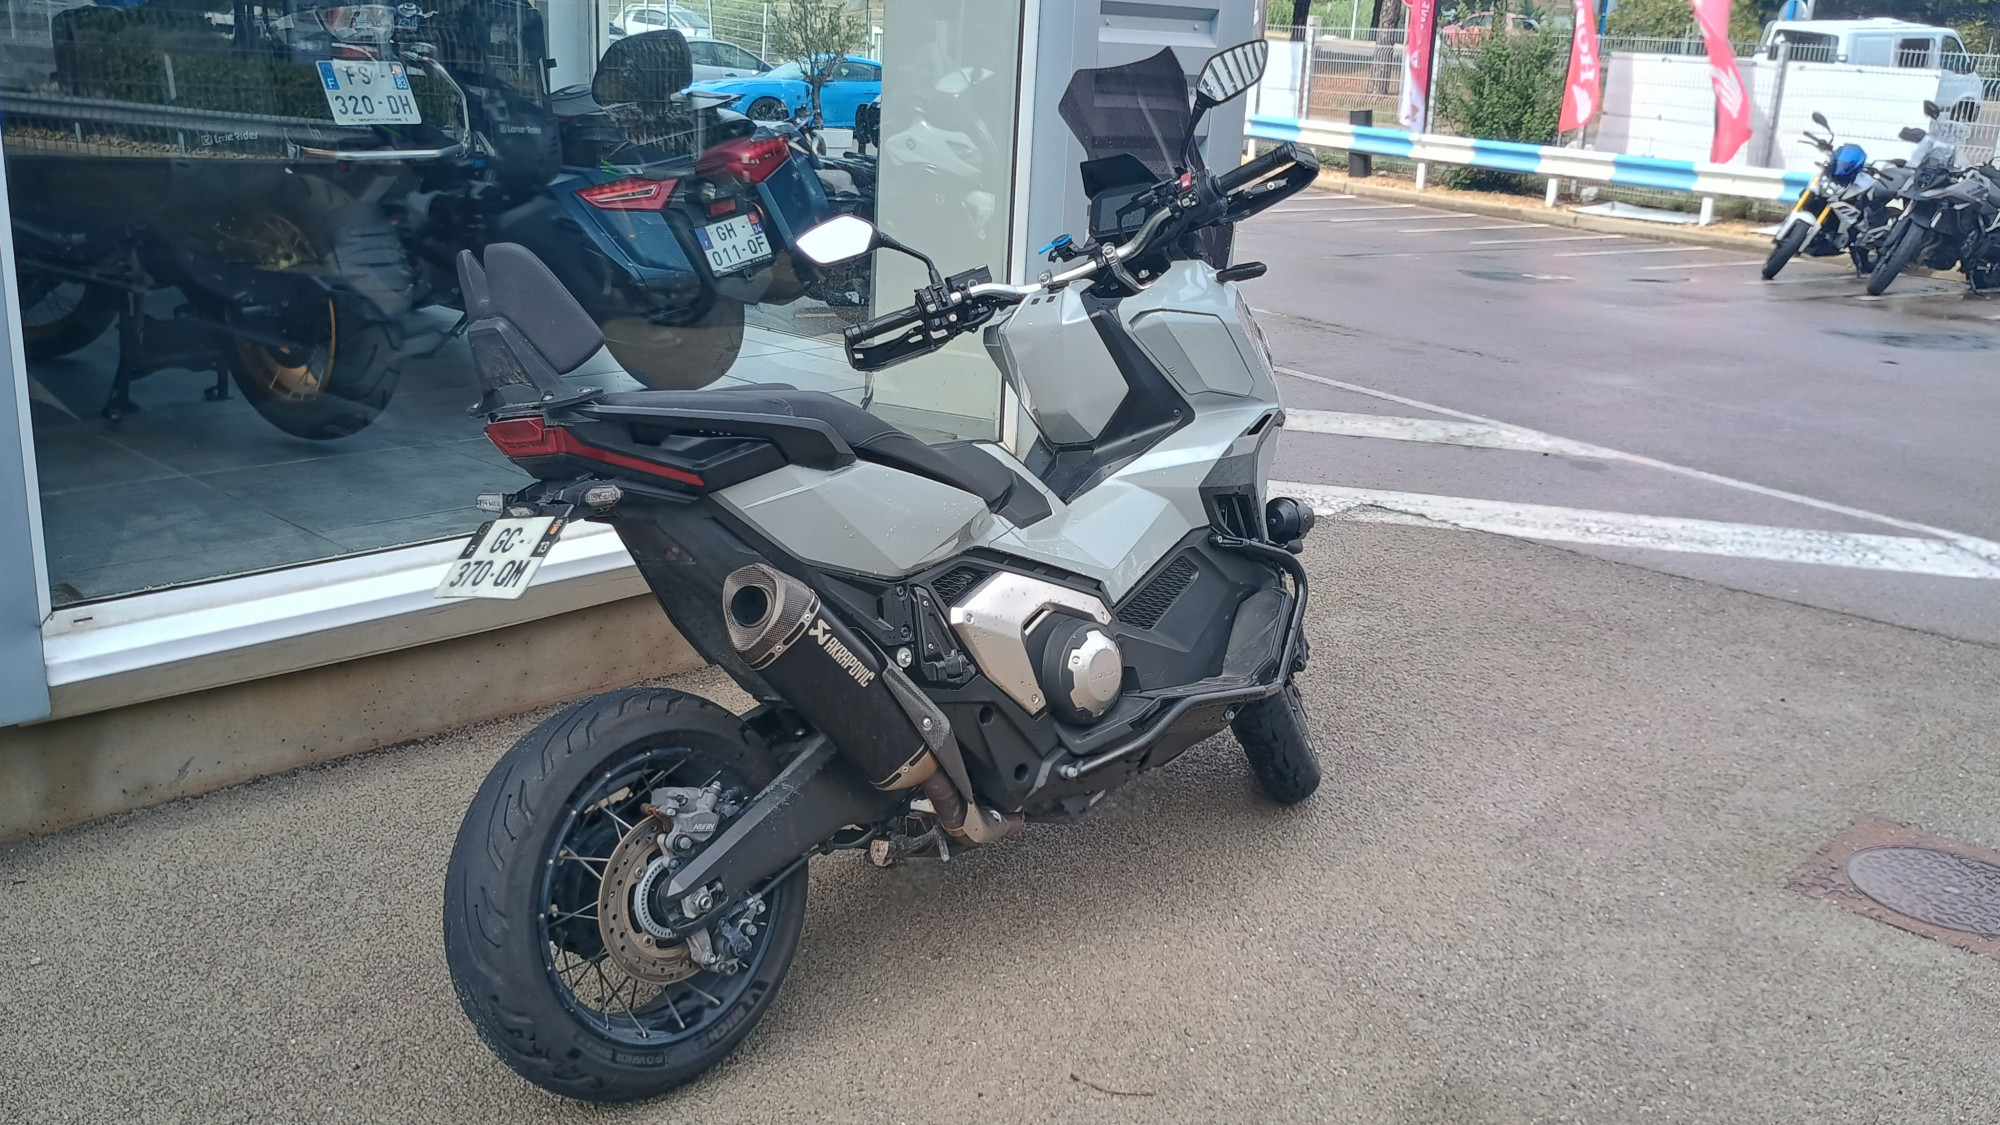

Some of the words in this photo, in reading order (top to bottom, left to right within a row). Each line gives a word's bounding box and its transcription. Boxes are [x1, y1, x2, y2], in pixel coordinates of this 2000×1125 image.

[327, 77, 334, 88] F
[397, 78, 408, 89] 83
[335, 95, 413, 115] 320-DH
[752, 224, 762, 234] 34
[712, 236, 765, 266] 011-QF
[466, 545, 476, 555] F
[537, 541, 550, 553] 13
[449, 560, 531, 588] 370-QM
[615, 1052, 664, 1065] POWER
